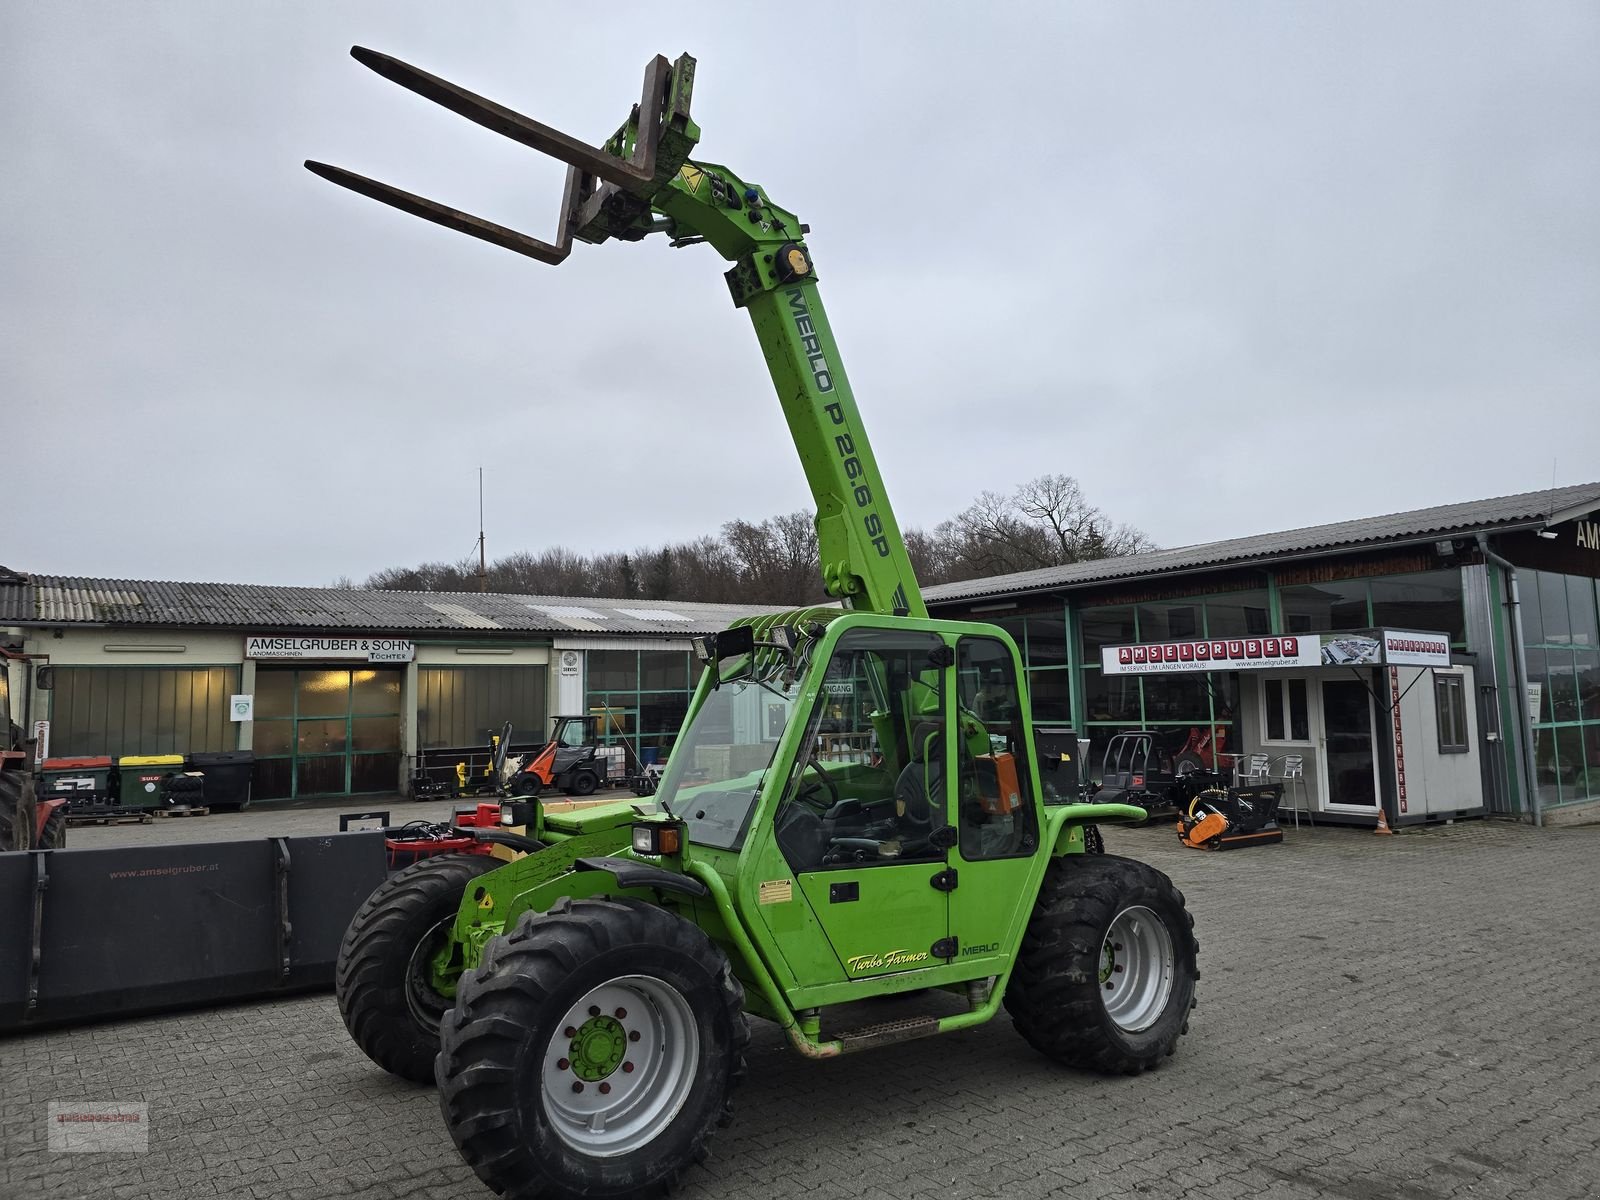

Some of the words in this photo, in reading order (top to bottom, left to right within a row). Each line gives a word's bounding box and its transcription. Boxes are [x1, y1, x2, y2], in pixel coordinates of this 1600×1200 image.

[785, 288, 834, 393] MERLO
[824, 402, 844, 425] P
[835, 432, 871, 507] 26.6
[863, 513, 890, 558] SP
[1576, 520, 1600, 550] AM
[250, 638, 357, 650] AMSELGRUBER
[361, 640, 369, 650] &
[372, 640, 410, 650] SOHN
[1119, 638, 1297, 663] AMSELGRUBER
[1235, 659, 1298, 667] www.amselgruber.at
[1390, 664, 1407, 813] AMSELGRUBER
[109, 863, 220, 879] www.amselgruber.at
[847, 954, 884, 973] Turbo
[884, 949, 928, 968] Farmer
[961, 942, 999, 956] MERLO
